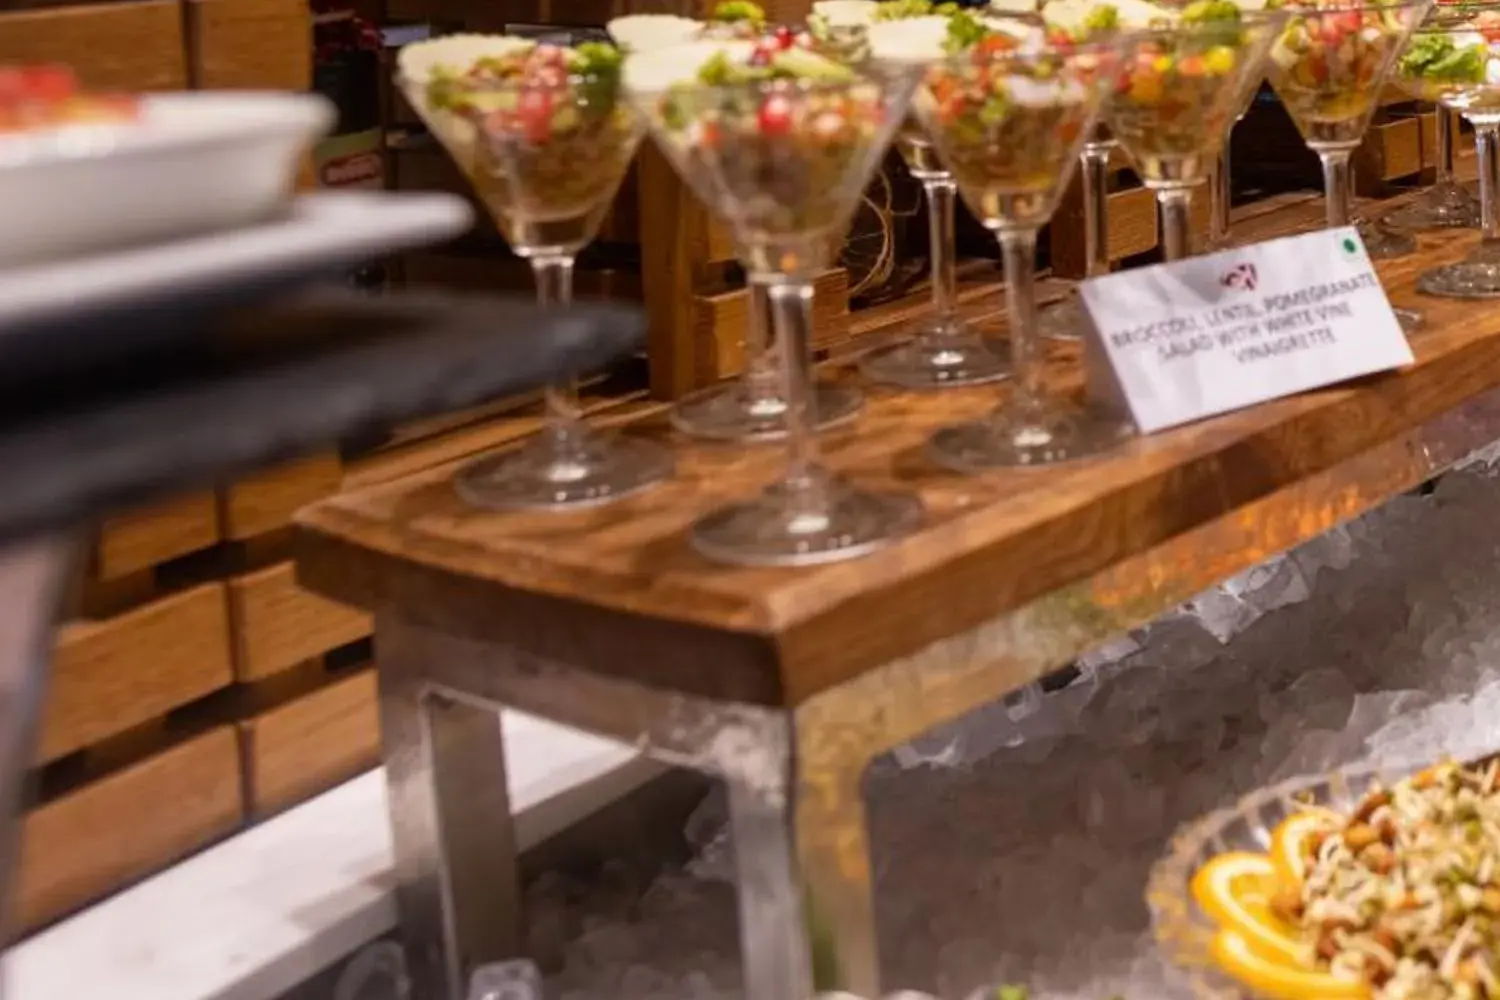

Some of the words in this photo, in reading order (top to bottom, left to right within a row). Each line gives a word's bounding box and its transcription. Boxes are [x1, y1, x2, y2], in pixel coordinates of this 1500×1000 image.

[1264, 271, 1377, 314] POMEGRANATE
[1157, 334, 1214, 362] SALAD
[1217, 322, 1262, 349] WITH
[1262, 308, 1315, 336] WHITE
[1233, 326, 1338, 364] VINAIGRETTE
